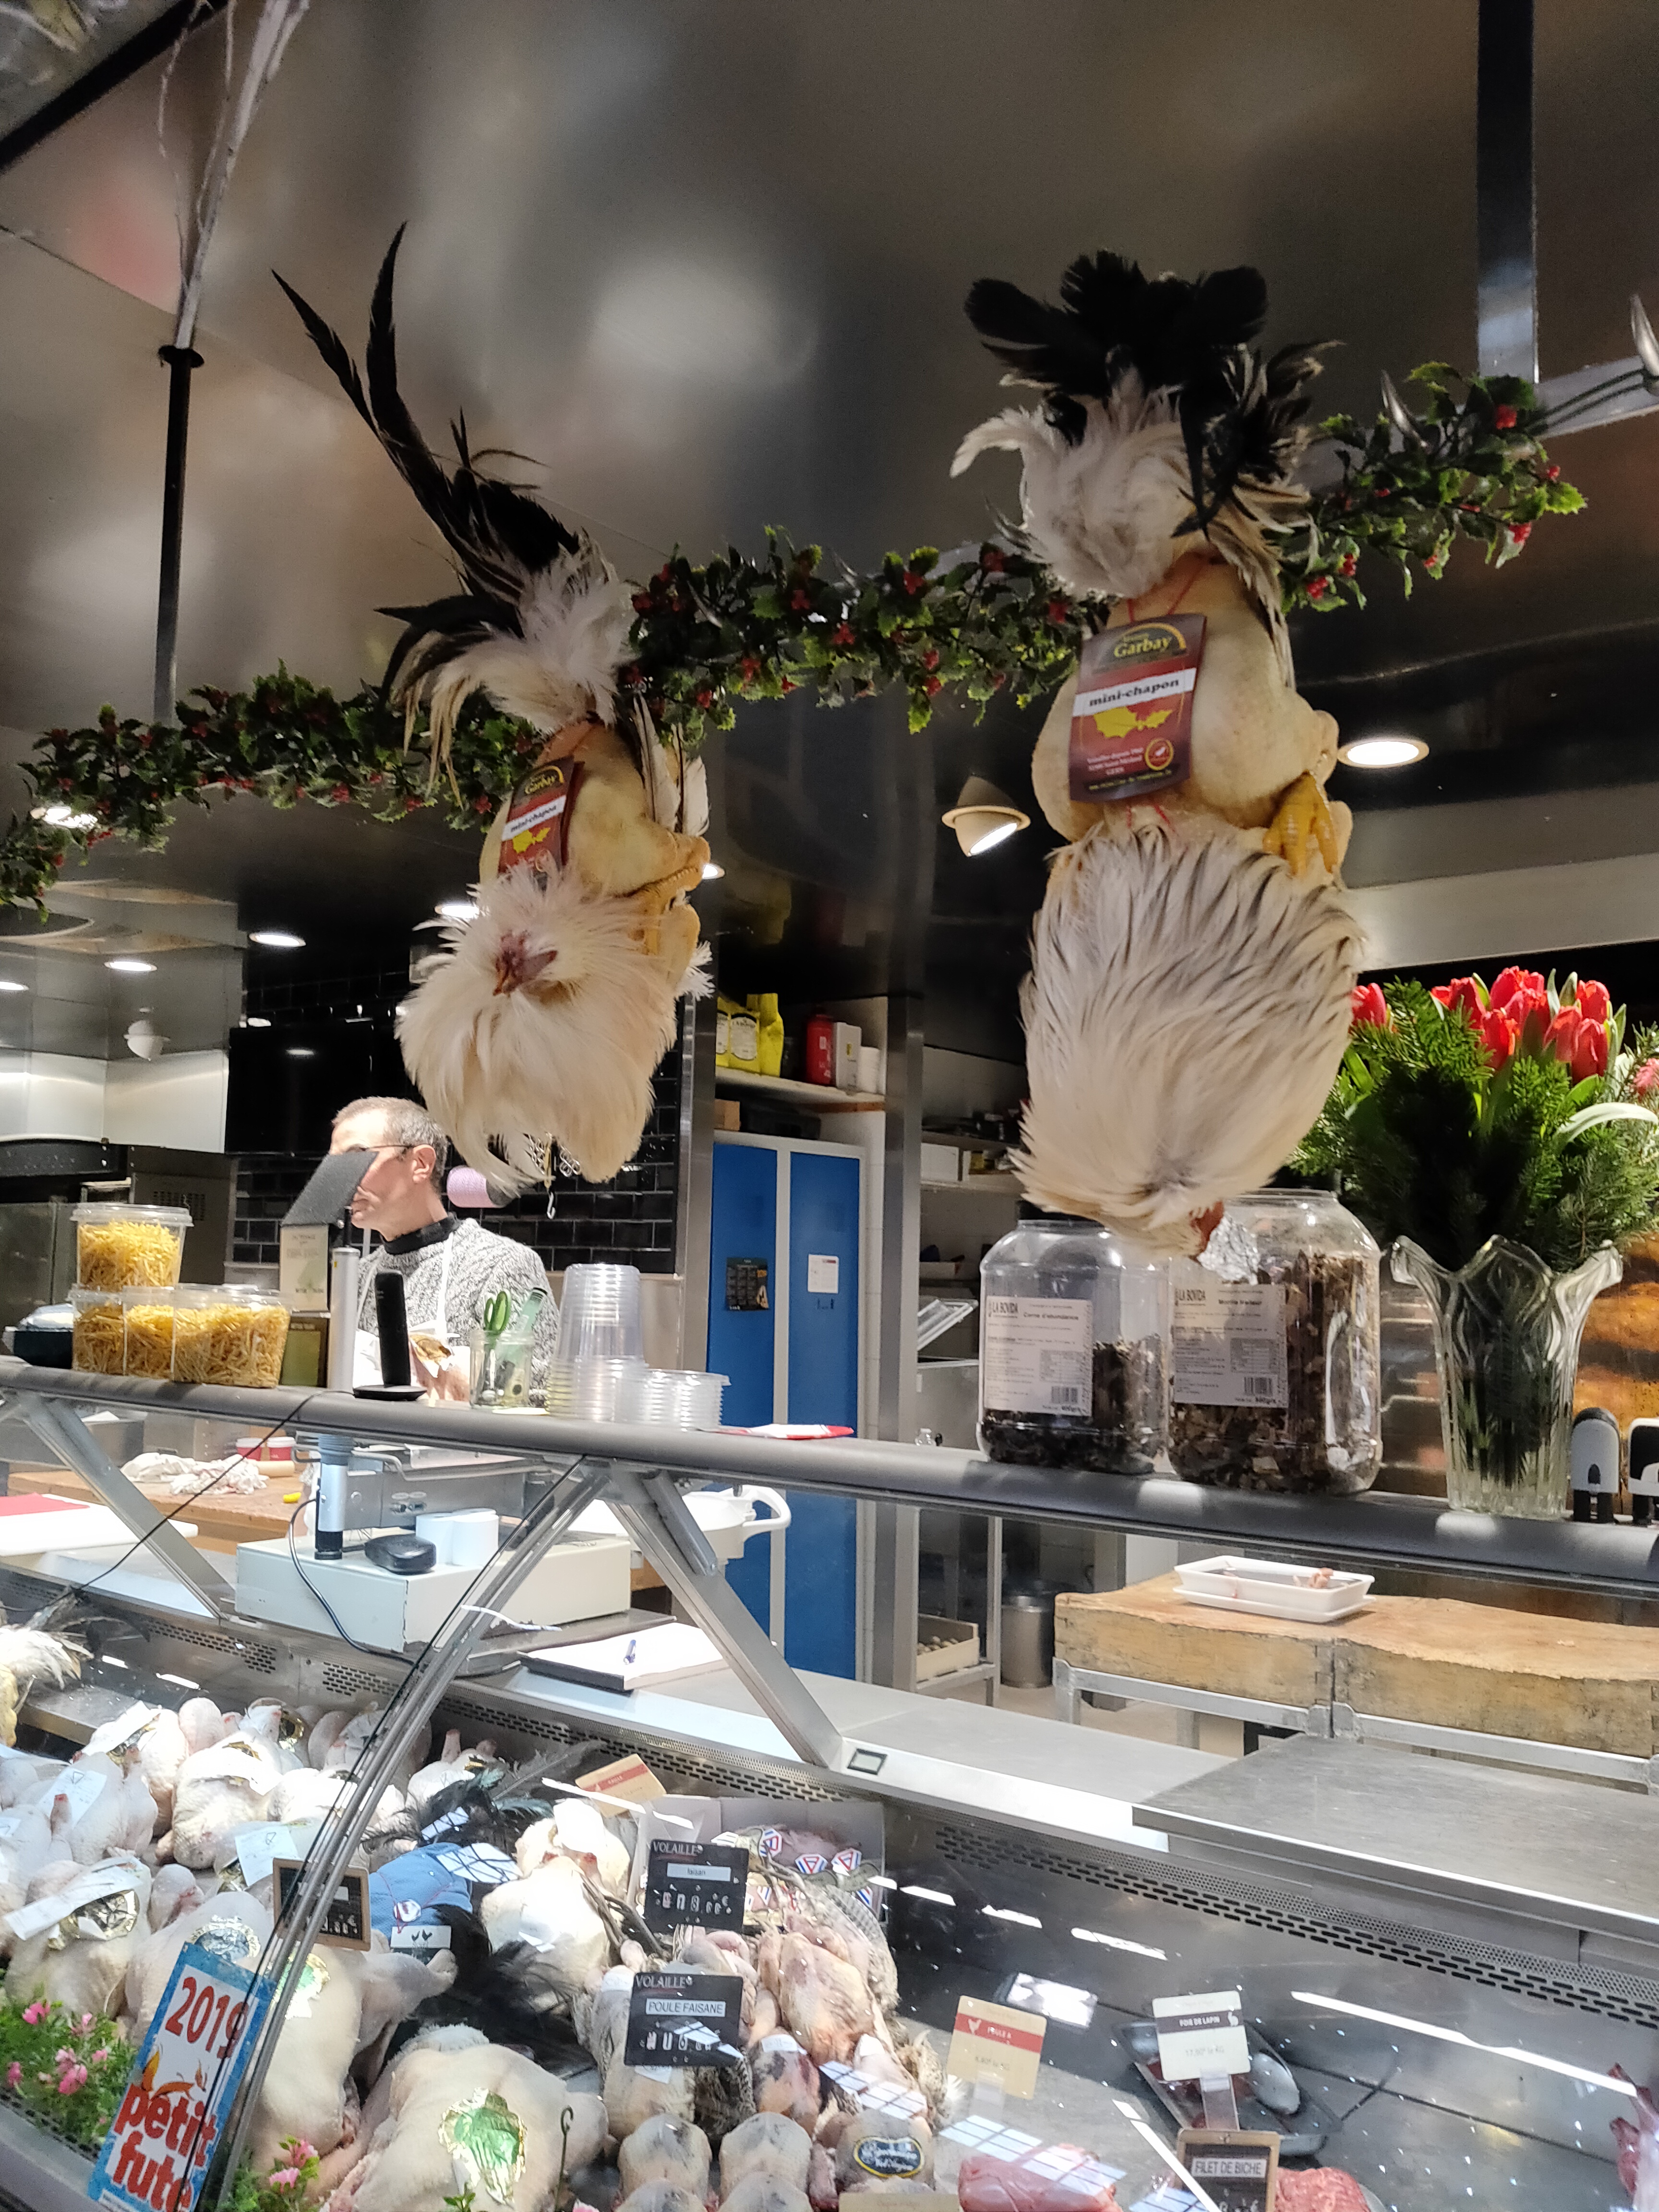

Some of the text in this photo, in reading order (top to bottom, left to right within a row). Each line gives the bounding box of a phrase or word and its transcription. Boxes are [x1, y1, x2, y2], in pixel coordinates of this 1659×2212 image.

[1114, 637, 1172, 658] Garbay
[1089, 678, 1179, 707] mini-chapon
[165, 1976, 250, 2059] 2019
[648, 2001, 724, 2014] POULE FAISANE
[113, 2084, 217, 2167] petit
[1195, 2161, 1262, 2175] FILET DE BICHE
